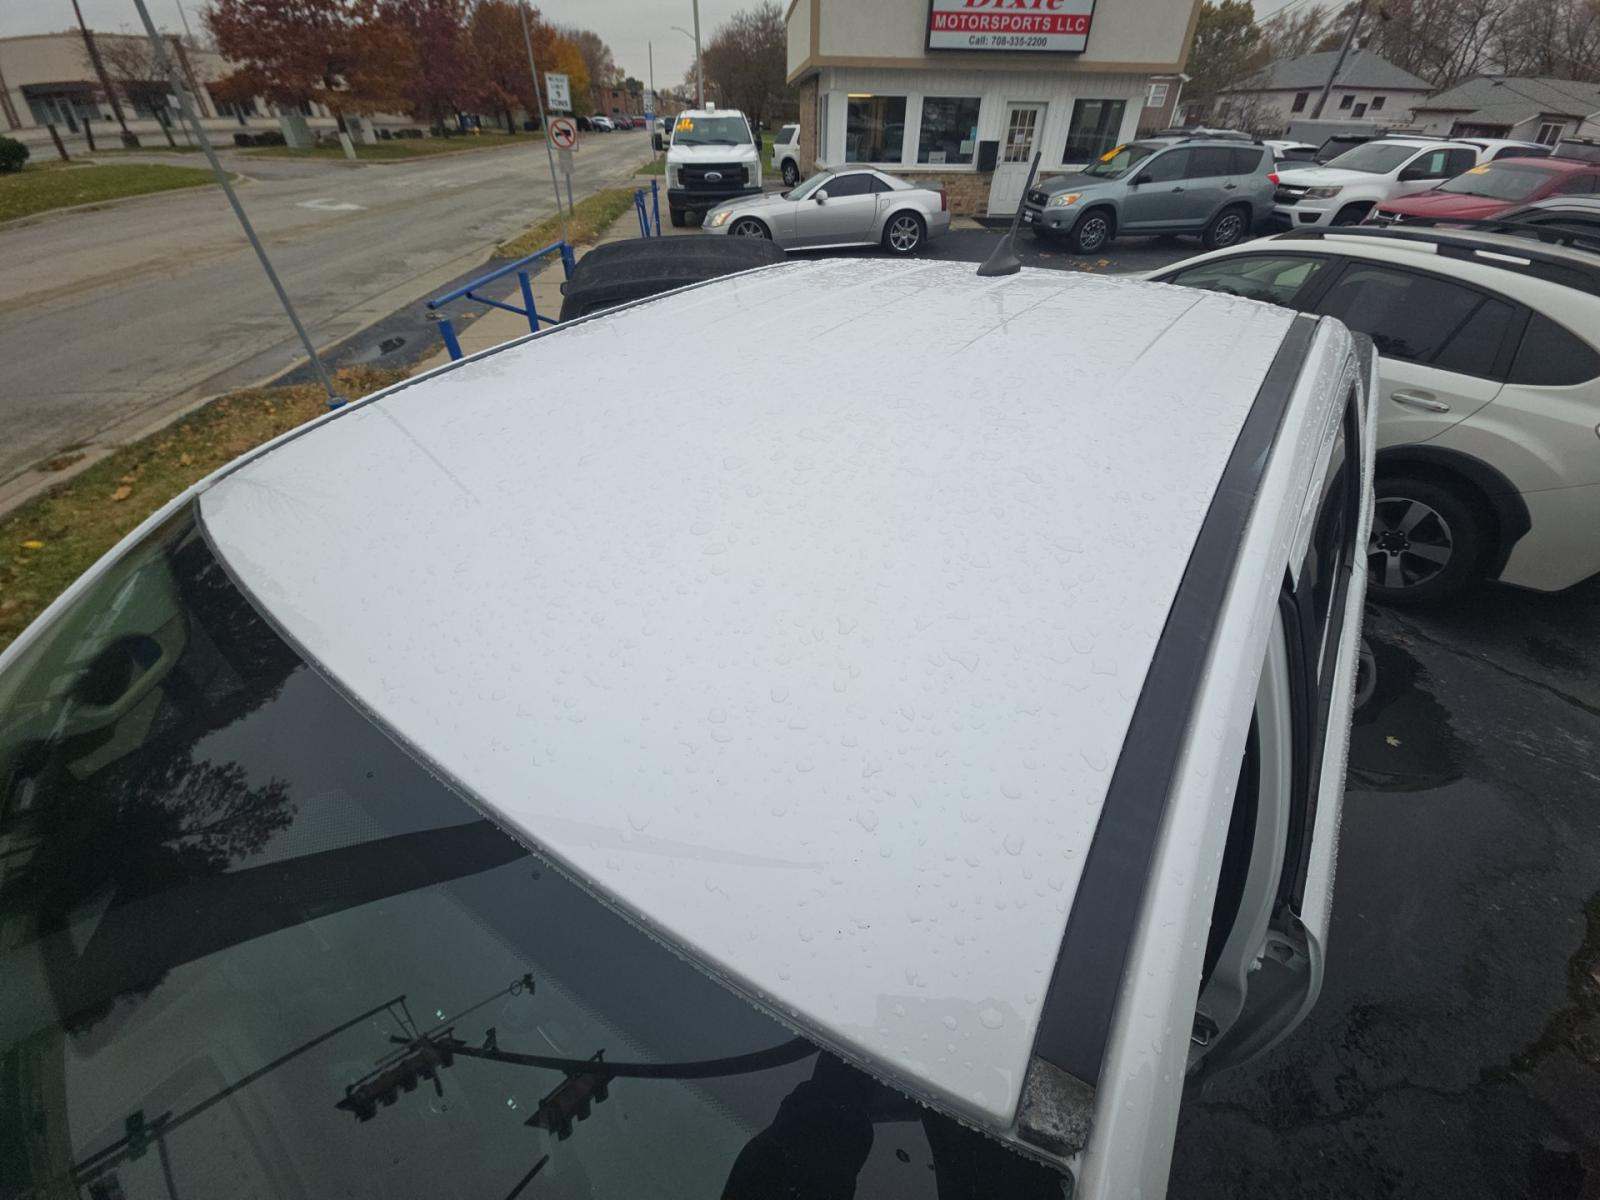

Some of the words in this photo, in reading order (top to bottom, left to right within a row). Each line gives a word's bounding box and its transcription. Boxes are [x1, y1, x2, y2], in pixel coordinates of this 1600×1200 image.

[935, 14, 1051, 31] MOTORSPORTS
[1057, 18, 1086, 32] LLC
[968, 35, 989, 46] Call:
[991, 36, 1048, 47] 708-335-2200
